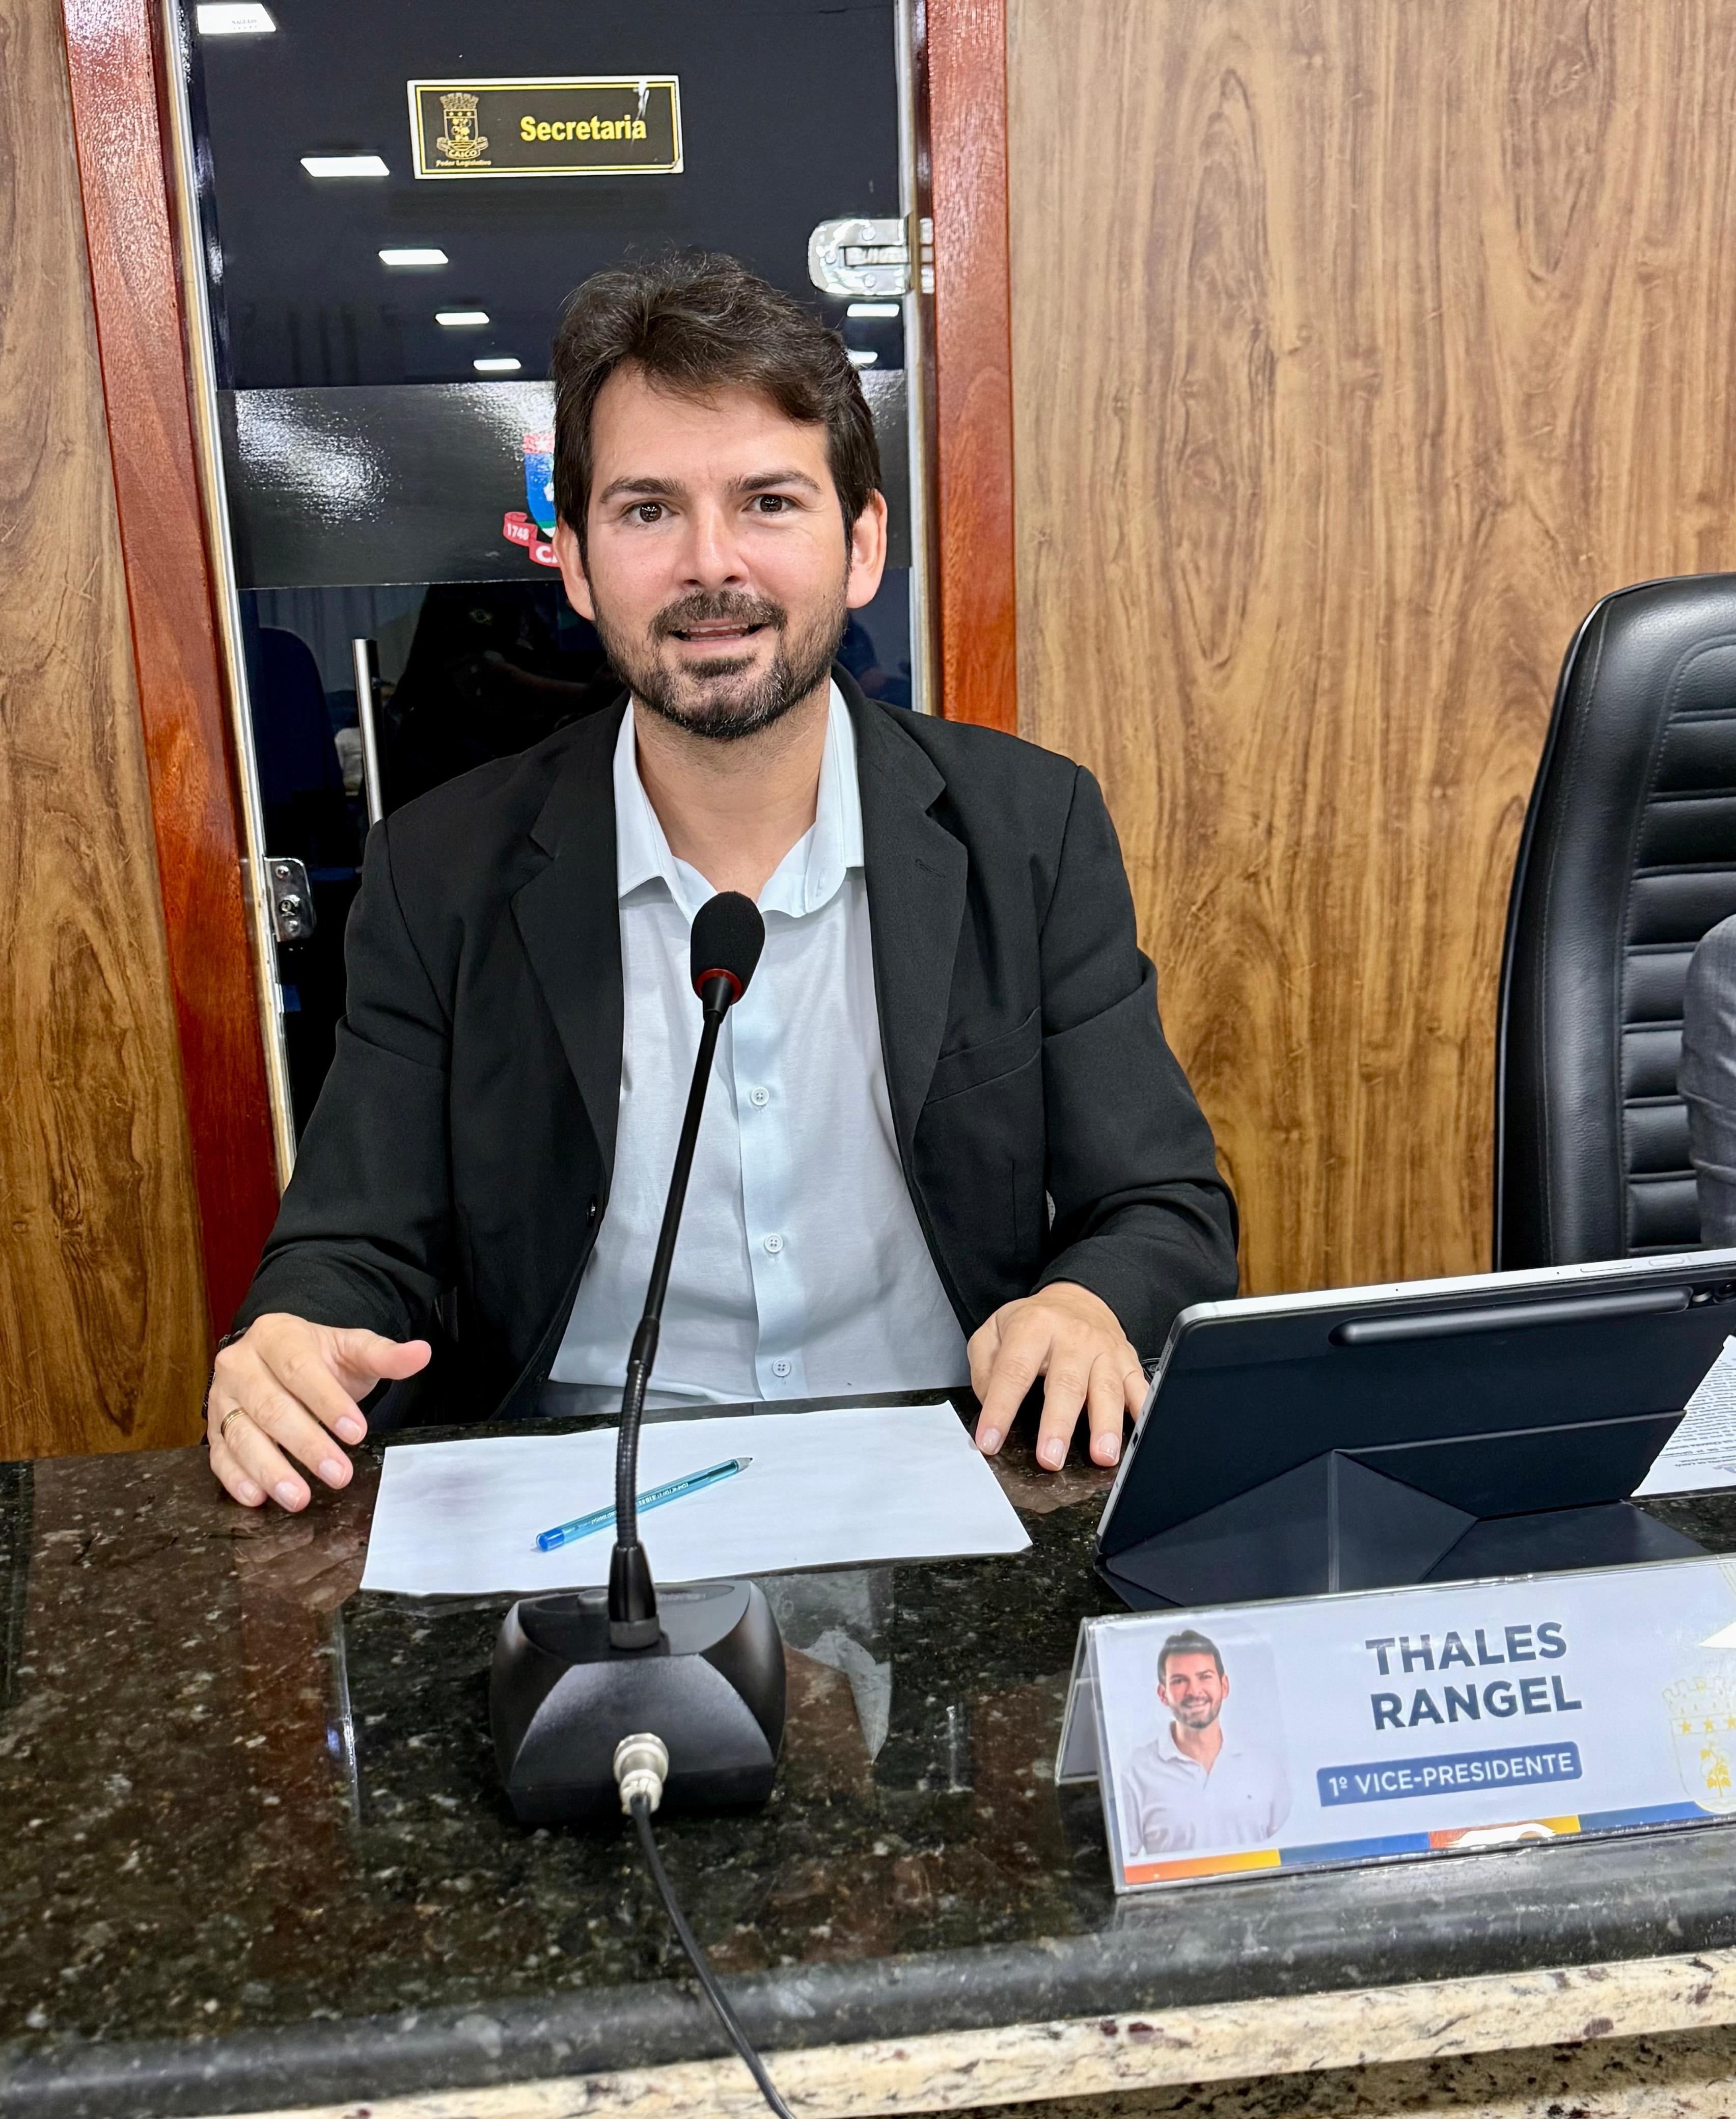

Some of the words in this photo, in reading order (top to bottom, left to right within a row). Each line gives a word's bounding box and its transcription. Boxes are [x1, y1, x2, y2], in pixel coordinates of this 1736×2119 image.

[520, 115, 646, 141] Secretaria
[507, 523, 530, 541] 1748
[1365, 1622, 1567, 1675] THALES
[1370, 1675, 1582, 1730] RANGEL
[1355, 1752, 1574, 1795] VICE-PRESIDENTE
